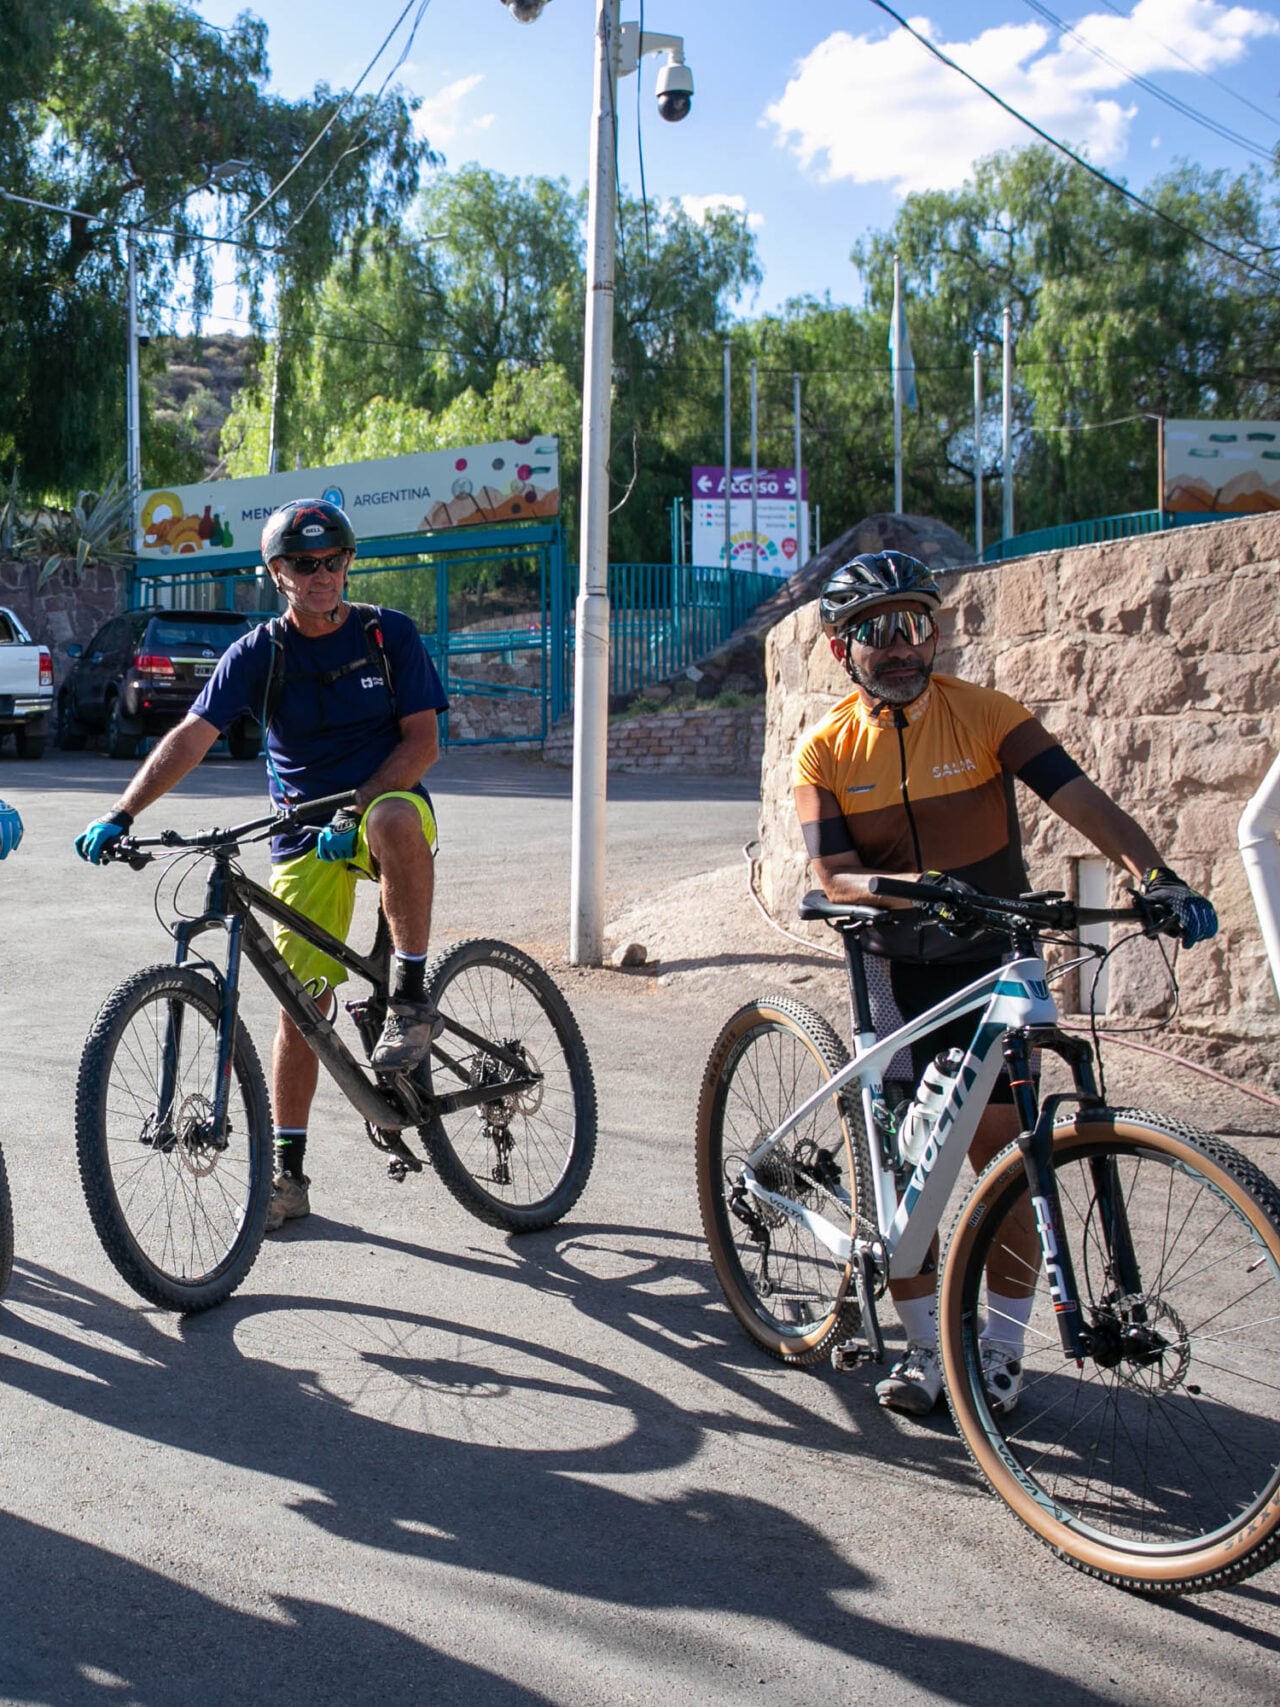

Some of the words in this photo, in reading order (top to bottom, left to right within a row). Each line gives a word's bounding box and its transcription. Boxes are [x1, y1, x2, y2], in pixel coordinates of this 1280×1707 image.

[354, 486, 431, 507] ARGENTINA
[490, 950, 535, 975] MAXXIS
[708, 1030, 737, 1086] MAXXIS
[771, 1197, 805, 1222] VOLTA
[998, 1443, 1039, 1496] VOLTA
